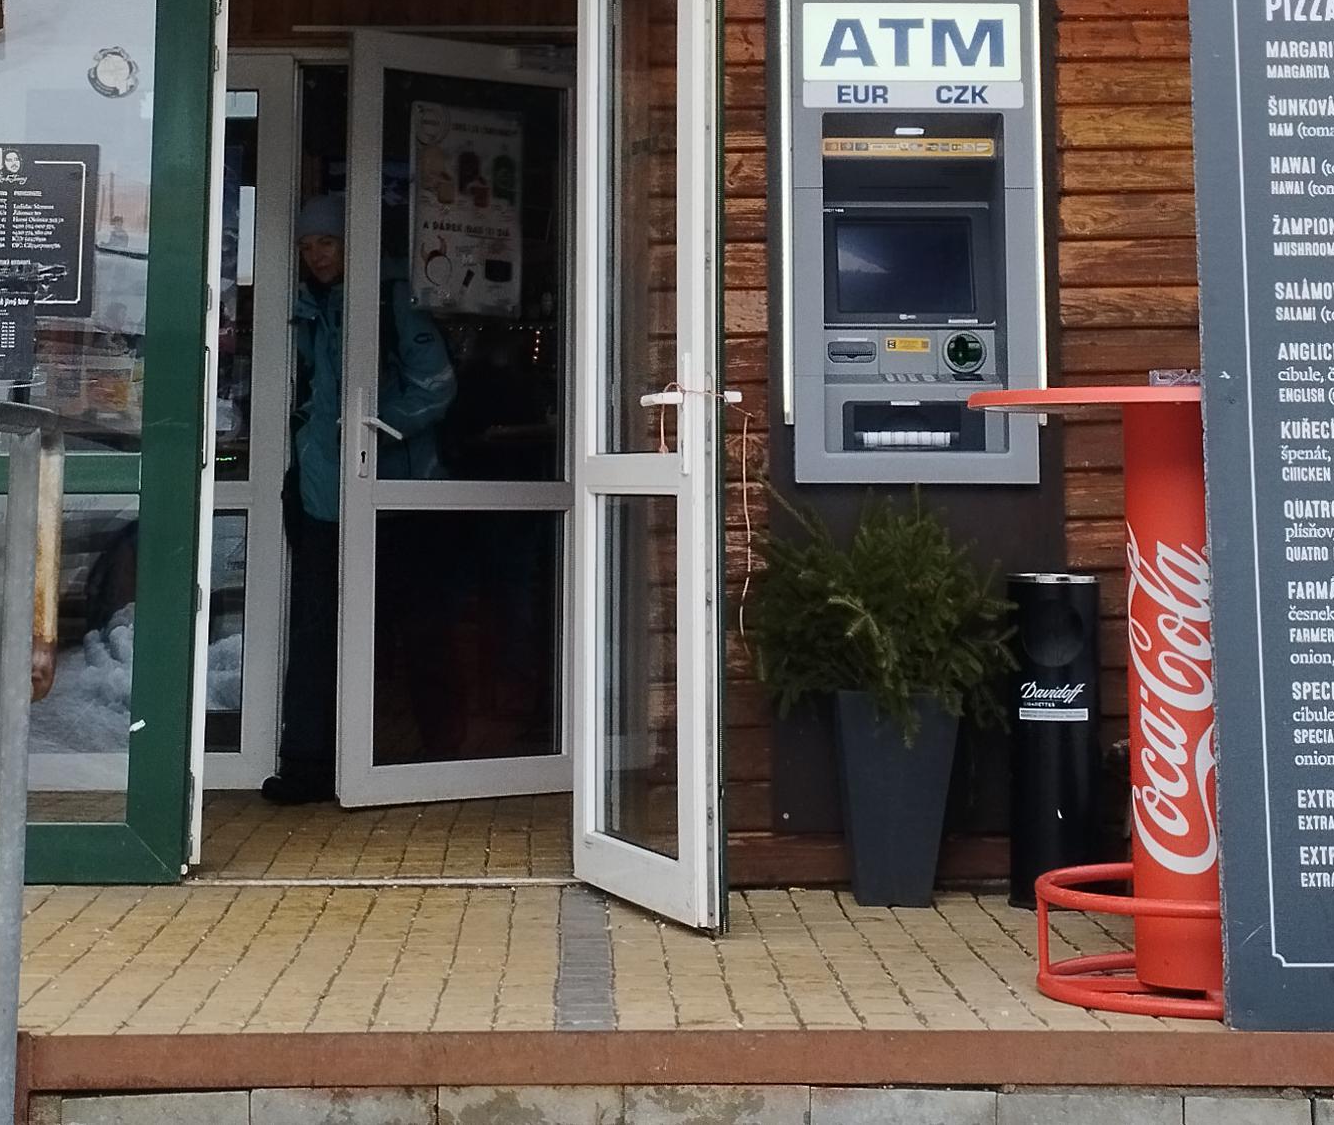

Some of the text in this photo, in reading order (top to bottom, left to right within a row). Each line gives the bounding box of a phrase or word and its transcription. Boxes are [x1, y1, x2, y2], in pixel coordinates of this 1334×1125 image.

[820, 18, 1005, 68] ATM
[837, 85, 989, 104] EUR CZK
[1270, 157, 1315, 173] HAWAI
[1277, 366, 1323, 383] cibule,
[1289, 649, 1334, 666] onion,
[1020, 681, 1086, 704] Davidoff
[1126, 522, 1217, 874] Coca-Cola
